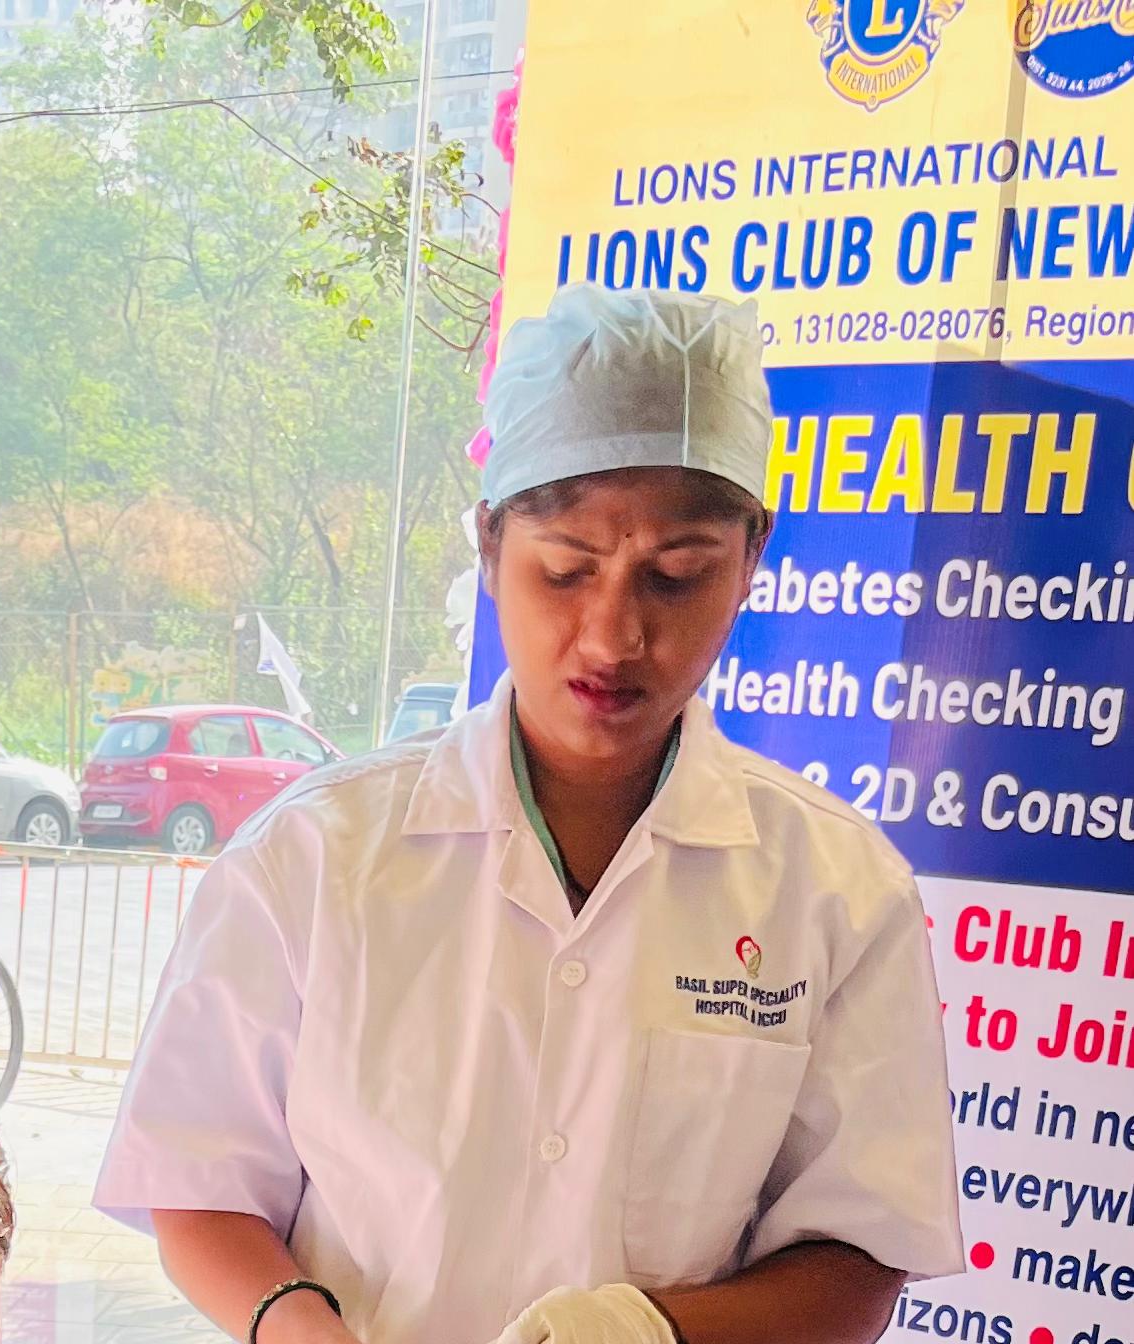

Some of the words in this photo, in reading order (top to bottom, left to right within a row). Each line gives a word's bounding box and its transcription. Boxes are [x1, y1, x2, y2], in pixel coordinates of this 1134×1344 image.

[835, 55, 921, 94] INTERNATIONAL
[614, 160, 737, 206] LIONS
[753, 135, 1118, 197] INTERNATIONAL
[557, 224, 710, 294] LIONS
[731, 215, 873, 294] CLUB
[898, 210, 976, 286] OF
[996, 203, 1134, 281] NEW
[760, 324, 781, 346] o.
[793, 306, 1012, 346] 131028-028076,
[764, 414, 1096, 514] HEALTH
[747, 556, 923, 617] abetes
[706, 656, 860, 718] Health
[871, 662, 1125, 747] Checking
[850, 765, 916, 823] 2D
[926, 770, 965, 829] &
[954, 905, 1082, 973] Club
[675, 975, 710, 995] BASIL
[965, 995, 1017, 1052] to
[950, 1082, 1021, 1132] rld
[1034, 1090, 1078, 1140] in
[962, 1164, 1134, 1229] everyw
[1011, 1246, 1134, 1302] make
